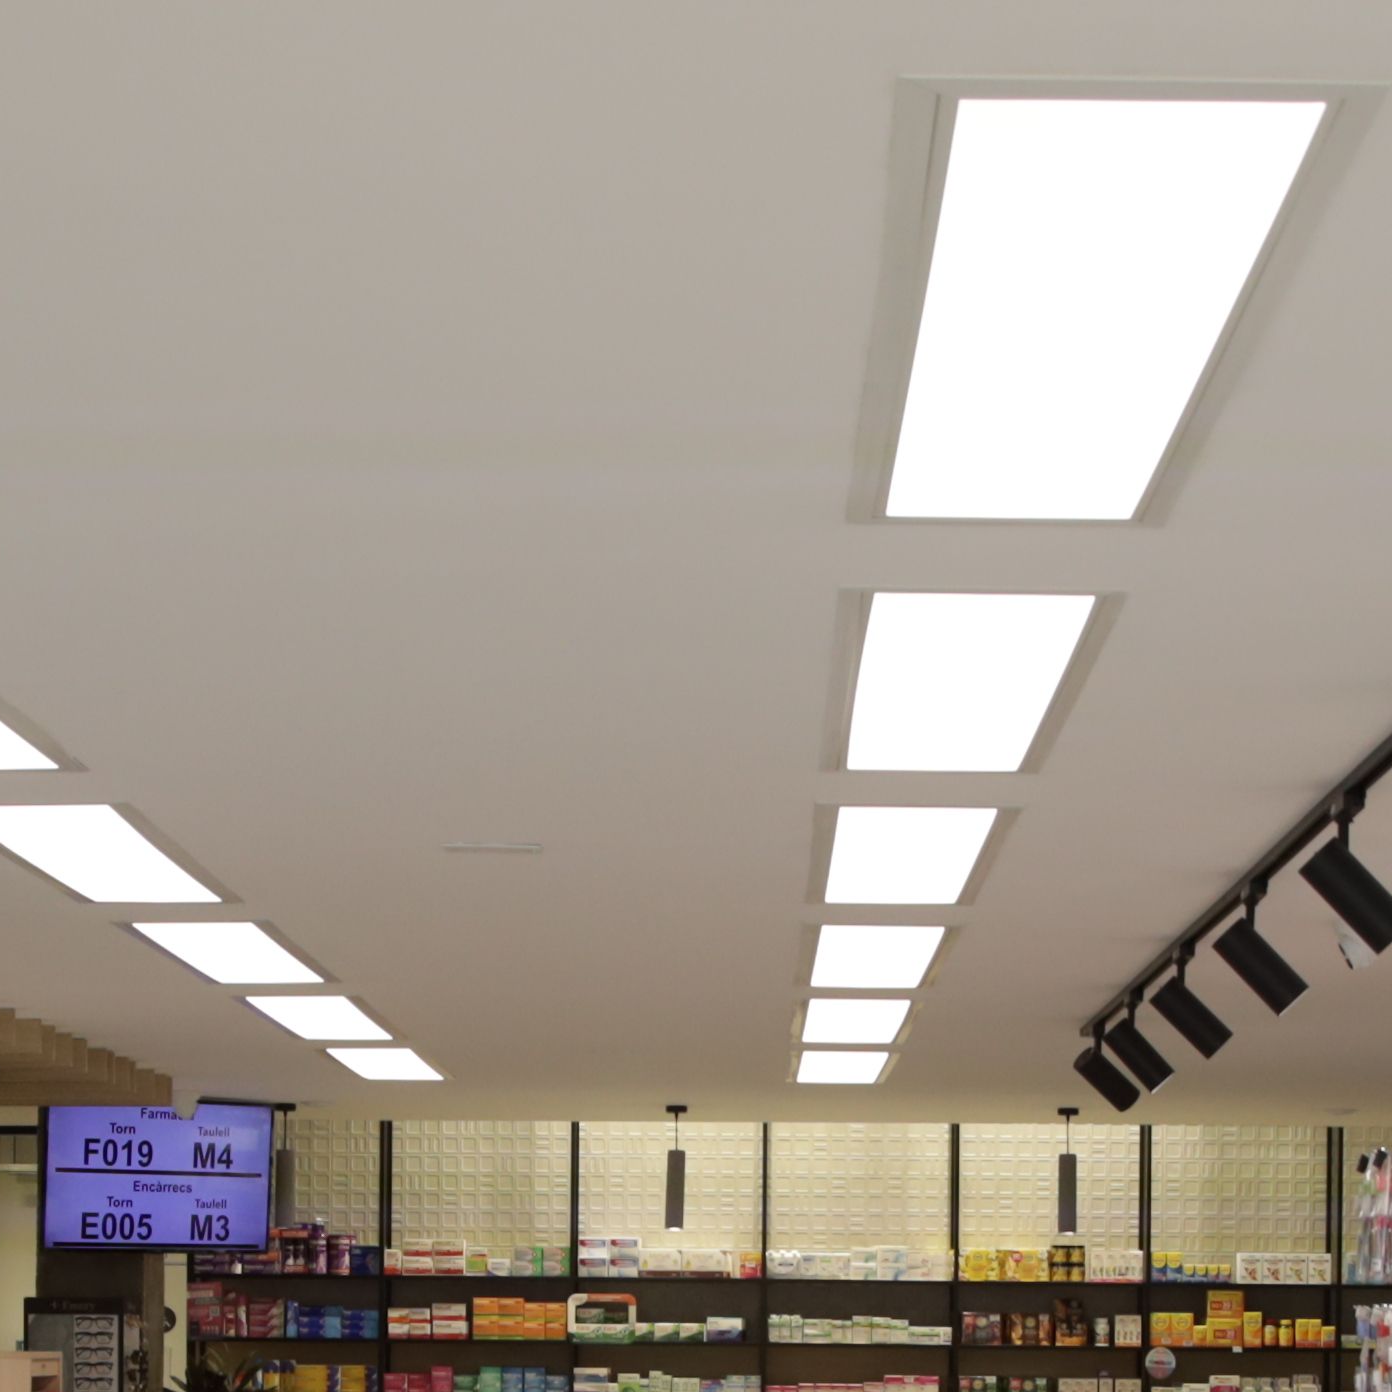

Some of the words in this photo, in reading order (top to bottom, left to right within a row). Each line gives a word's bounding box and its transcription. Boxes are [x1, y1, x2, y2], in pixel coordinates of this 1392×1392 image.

[140, 1108, 194, 1120] Farma
[110, 1123, 136, 1134] Torn
[198, 1126, 230, 1137] Taulell
[83, 1138, 153, 1167] F019
[193, 1142, 233, 1170] M4
[133, 1180, 193, 1194] Encàrrecs
[107, 1196, 133, 1208] Torn
[195, 1199, 227, 1209] Taulell
[81, 1212, 153, 1241] E005
[190, 1214, 230, 1241] M3
